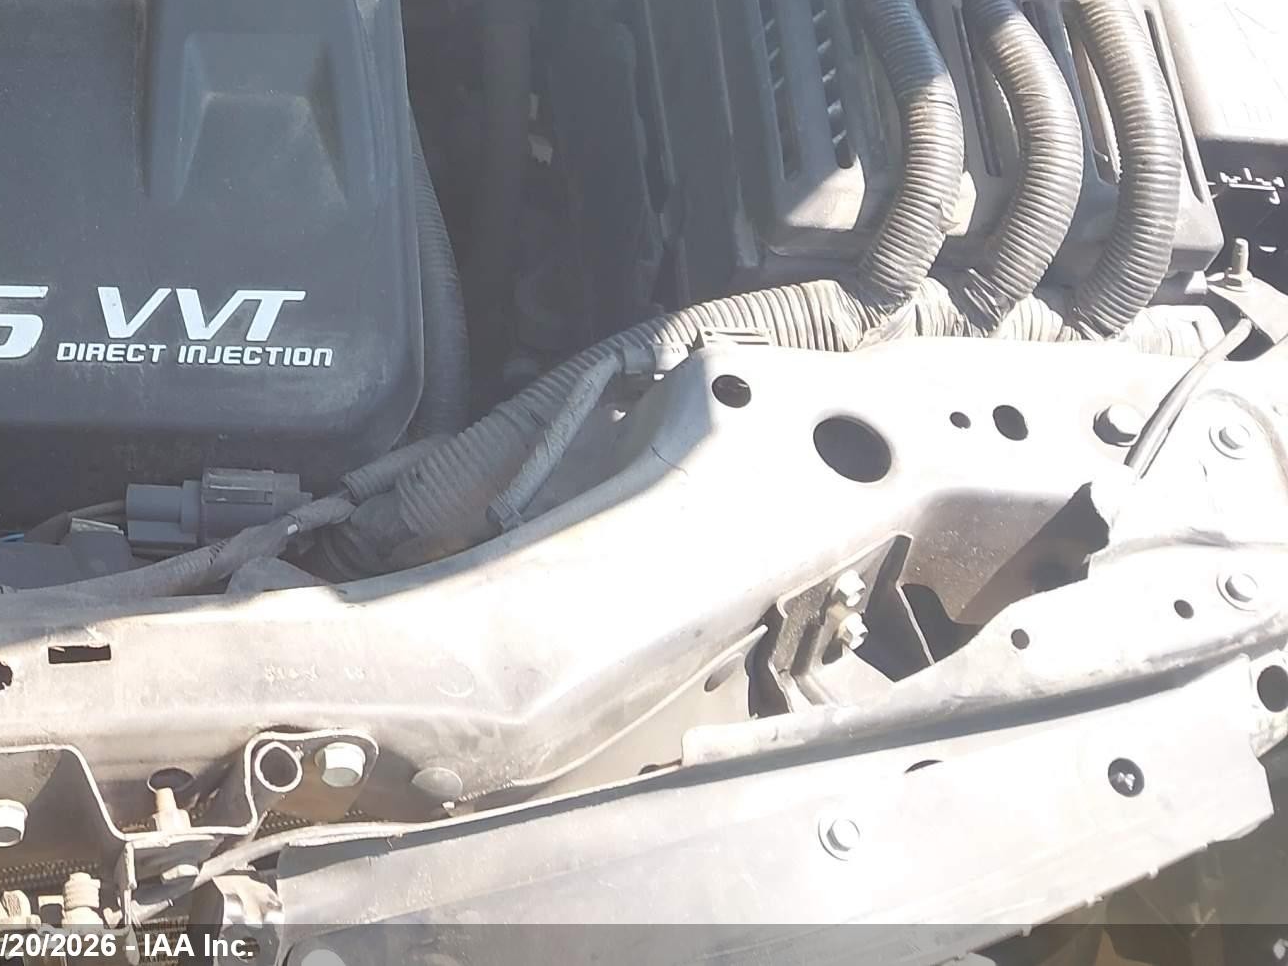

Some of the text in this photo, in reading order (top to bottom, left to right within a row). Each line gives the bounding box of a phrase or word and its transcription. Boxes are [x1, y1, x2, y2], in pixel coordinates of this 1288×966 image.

[97, 286, 307, 342] VVT
[55, 342, 334, 367] DIRECT INJECTION
